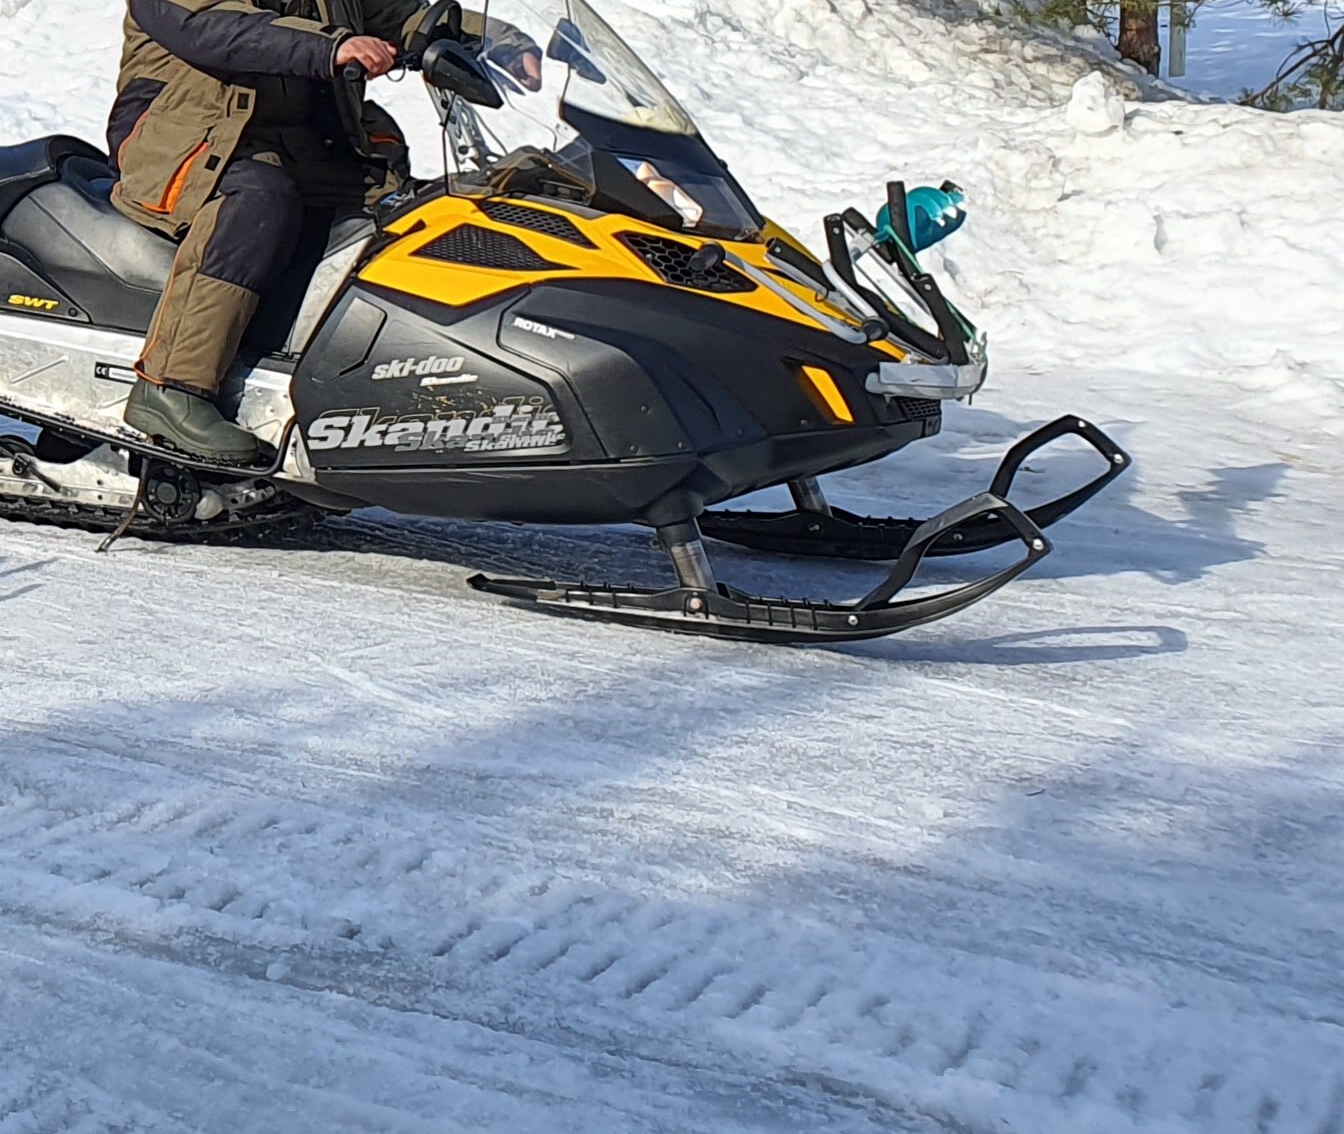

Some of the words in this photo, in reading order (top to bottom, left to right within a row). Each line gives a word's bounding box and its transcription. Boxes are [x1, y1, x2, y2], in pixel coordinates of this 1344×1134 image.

[8, 294, 59, 310] SWT
[514, 317, 557, 339] ROTAX
[371, 355, 465, 380] ski-doo
